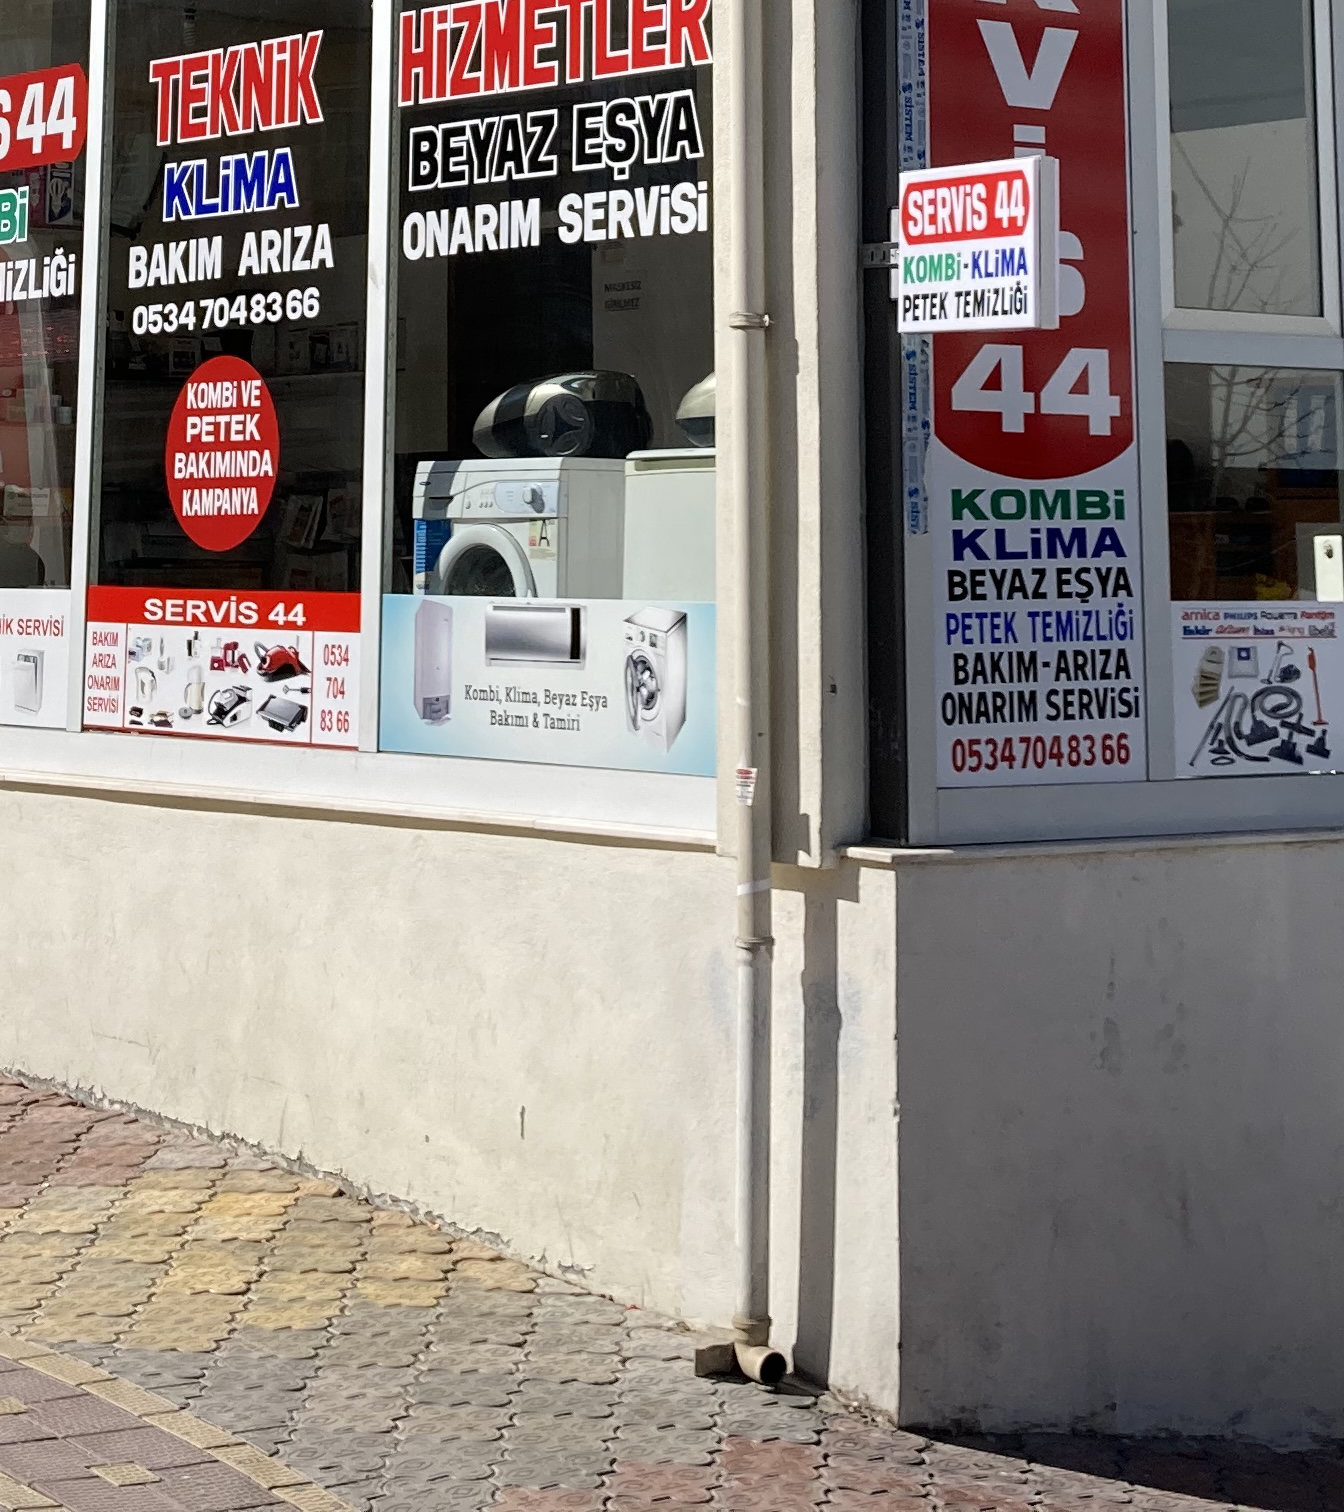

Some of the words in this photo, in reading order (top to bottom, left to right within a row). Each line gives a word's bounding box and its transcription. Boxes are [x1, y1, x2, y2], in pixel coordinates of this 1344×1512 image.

[16, 75, 77, 156] 44
[408, 108, 558, 192] BEYAZ
[572, 88, 705, 181] EŞYA
[993, 178, 1026, 230] 44
[402, 197, 541, 261] ONARIM
[128, 234, 223, 289] BAKIM
[237, 222, 335, 277] ARIZA
[902, 290, 949, 323] PETEK
[240, 379, 262, 408] VE
[950, 342, 1122, 437] 44
[186, 413, 261, 444] PETEK
[174, 448, 274, 480] BAKIMINDA
[182, 486, 260, 517] KAMPANYA
[947, 567, 1048, 603] BEYAZ
[1056, 566, 1134, 604] EŞYA
[17, 614, 65, 637] SERVİSİ
[143, 595, 259, 625] SERVİS
[268, 602, 307, 626] 44
[92, 631, 119, 647] BAKIM
[945, 610, 1019, 646] PETEK
[92, 653, 117, 669] ARIZA
[323, 644, 350, 667] 0534
[87, 675, 121, 690] ONARIM
[326, 677, 346, 700] 704
[464, 684, 503, 706] Kombi,
[505, 686, 541, 707] Klima,
[543, 688, 578, 710] Beyaz
[581, 691, 609, 712] Eşya
[320, 709, 334, 733] 83
[336, 710, 350, 733] 66
[489, 709, 530, 728] Bakımı
[532, 713, 540, 729] &
[542, 713, 582, 732] Tamiri
[941, 689, 1039, 727] ONARIM
